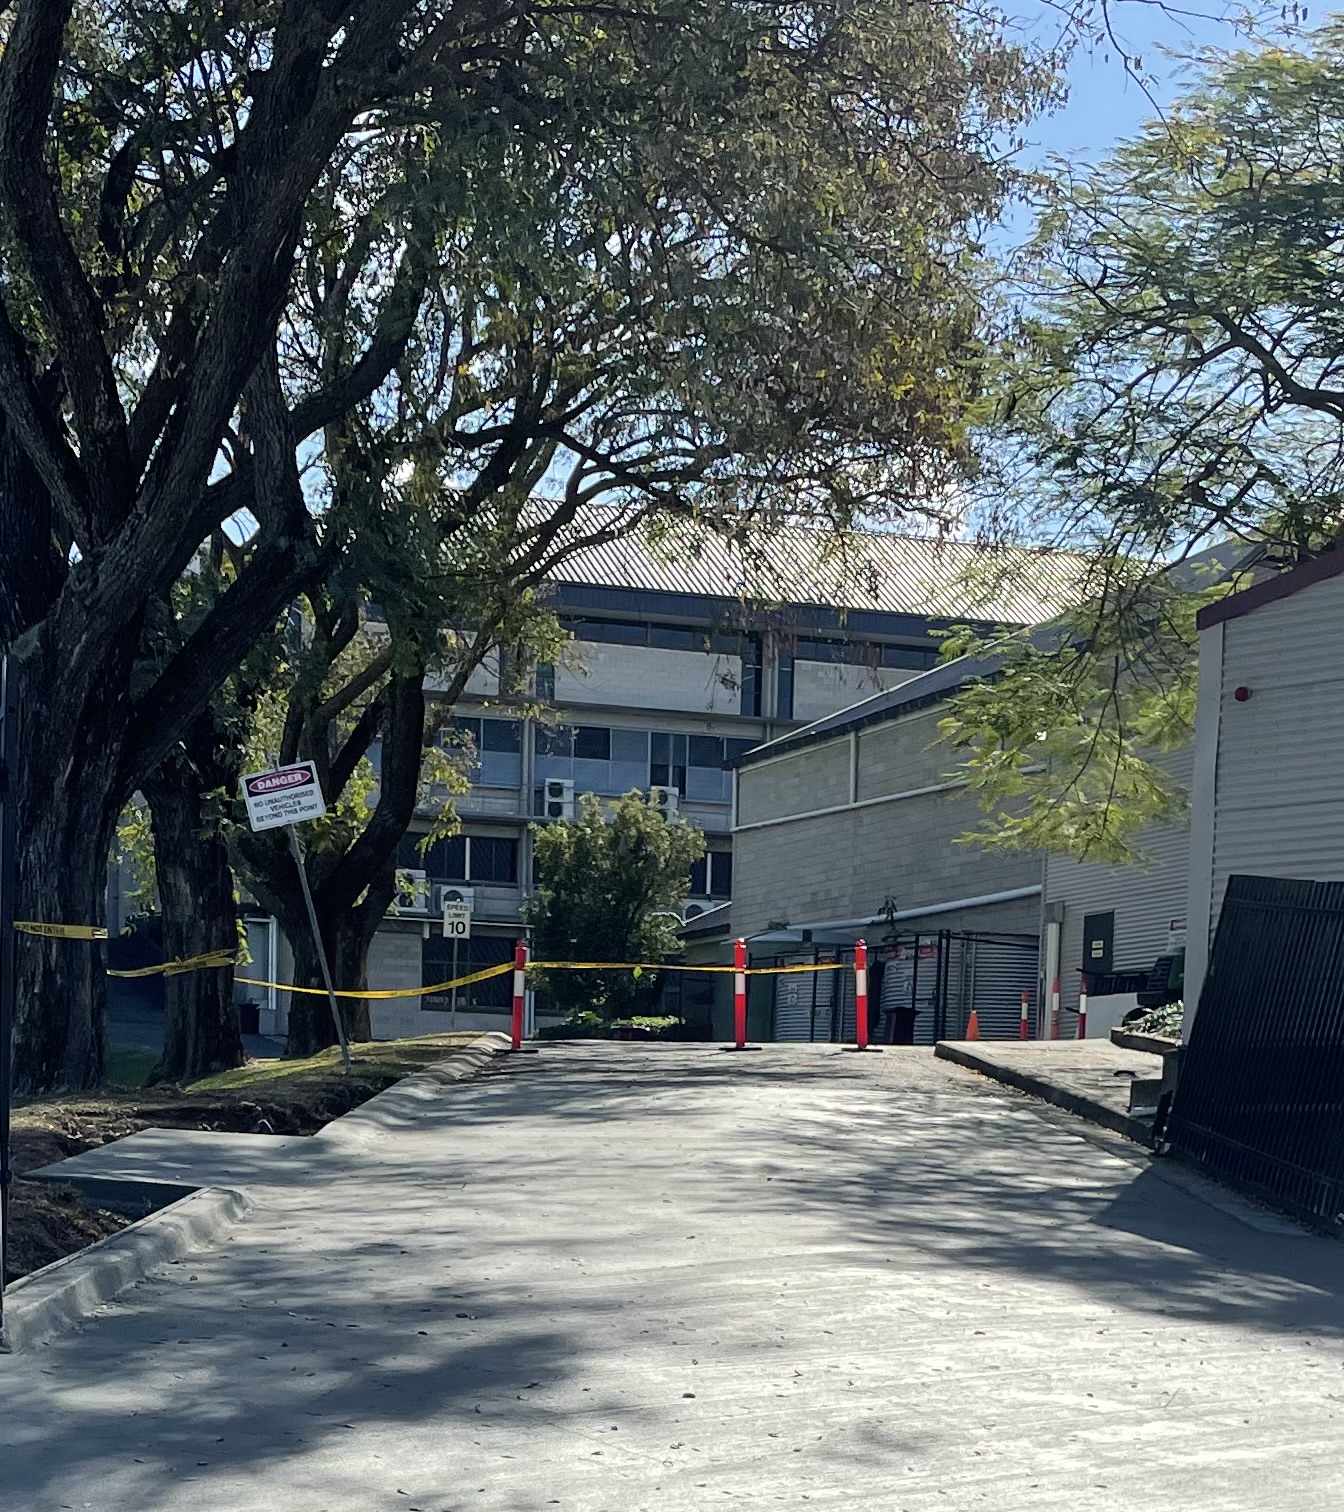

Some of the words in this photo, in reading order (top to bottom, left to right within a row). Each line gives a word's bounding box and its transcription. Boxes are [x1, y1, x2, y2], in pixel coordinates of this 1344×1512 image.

[257, 773, 303, 790] DANGER
[254, 800, 264, 808] NO
[269, 799, 302, 812] VEHICLES
[256, 812, 283, 823] BEYOND
[284, 807, 299, 817] THIS
[299, 803, 318, 813] POINT
[446, 903, 469, 912] SPEED
[448, 911, 466, 919] LIMIT
[447, 920, 466, 935] 10
